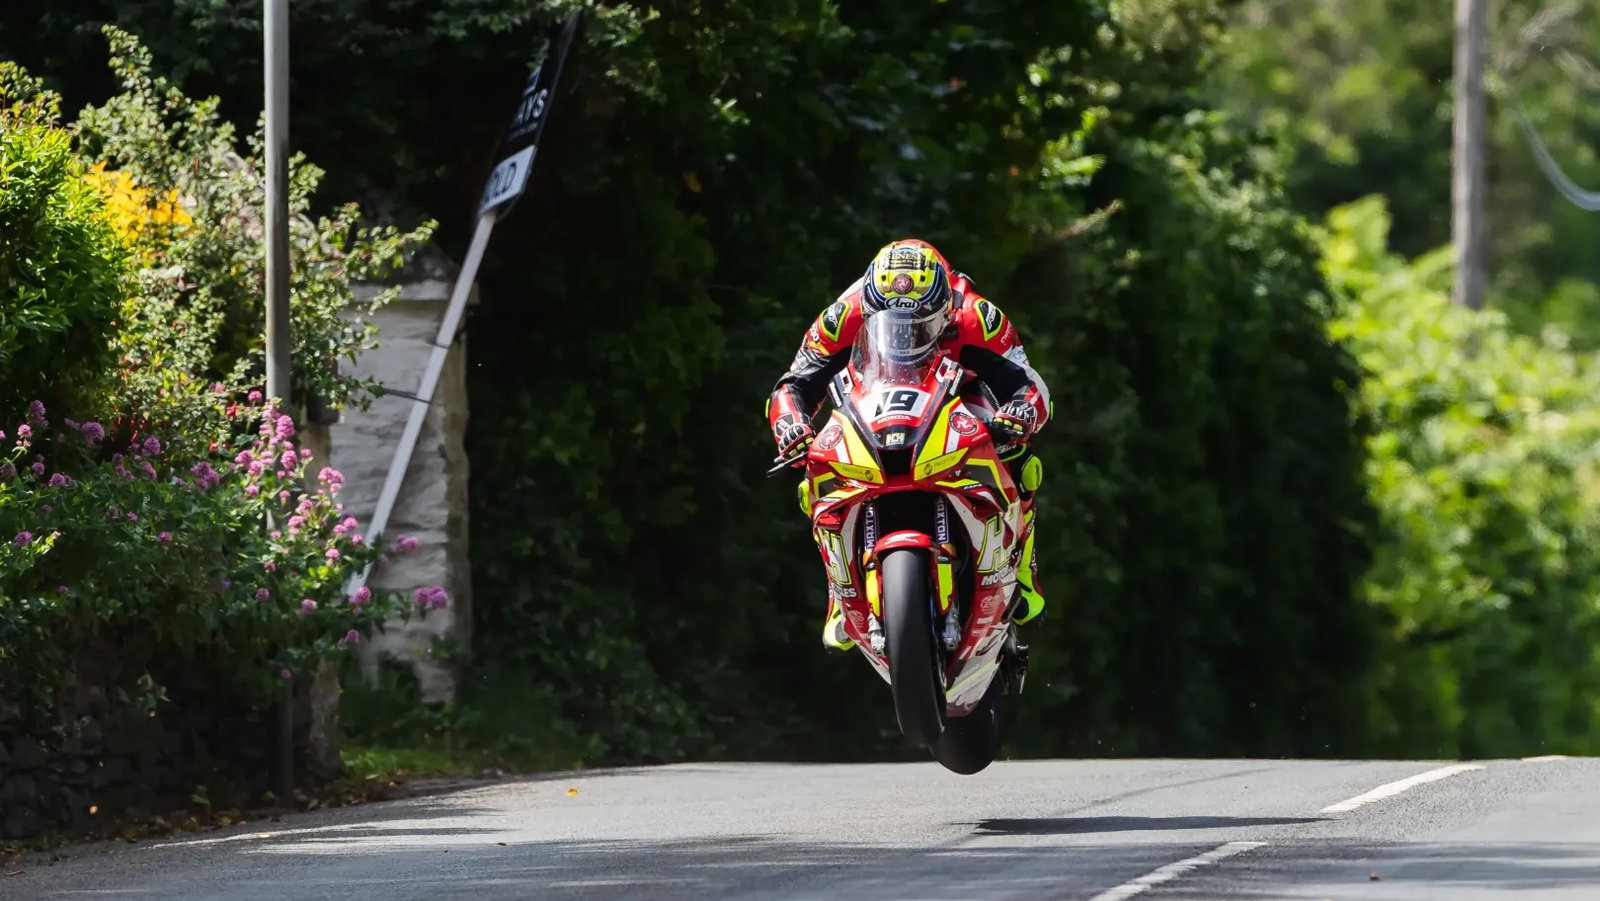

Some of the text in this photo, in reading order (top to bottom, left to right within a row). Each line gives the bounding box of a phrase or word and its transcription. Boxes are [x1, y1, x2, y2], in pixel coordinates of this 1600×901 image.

[888, 297, 917, 308] Arai
[874, 390, 920, 418] 19
[877, 414, 912, 424] HONDA
[865, 505, 876, 550] MAXTO
